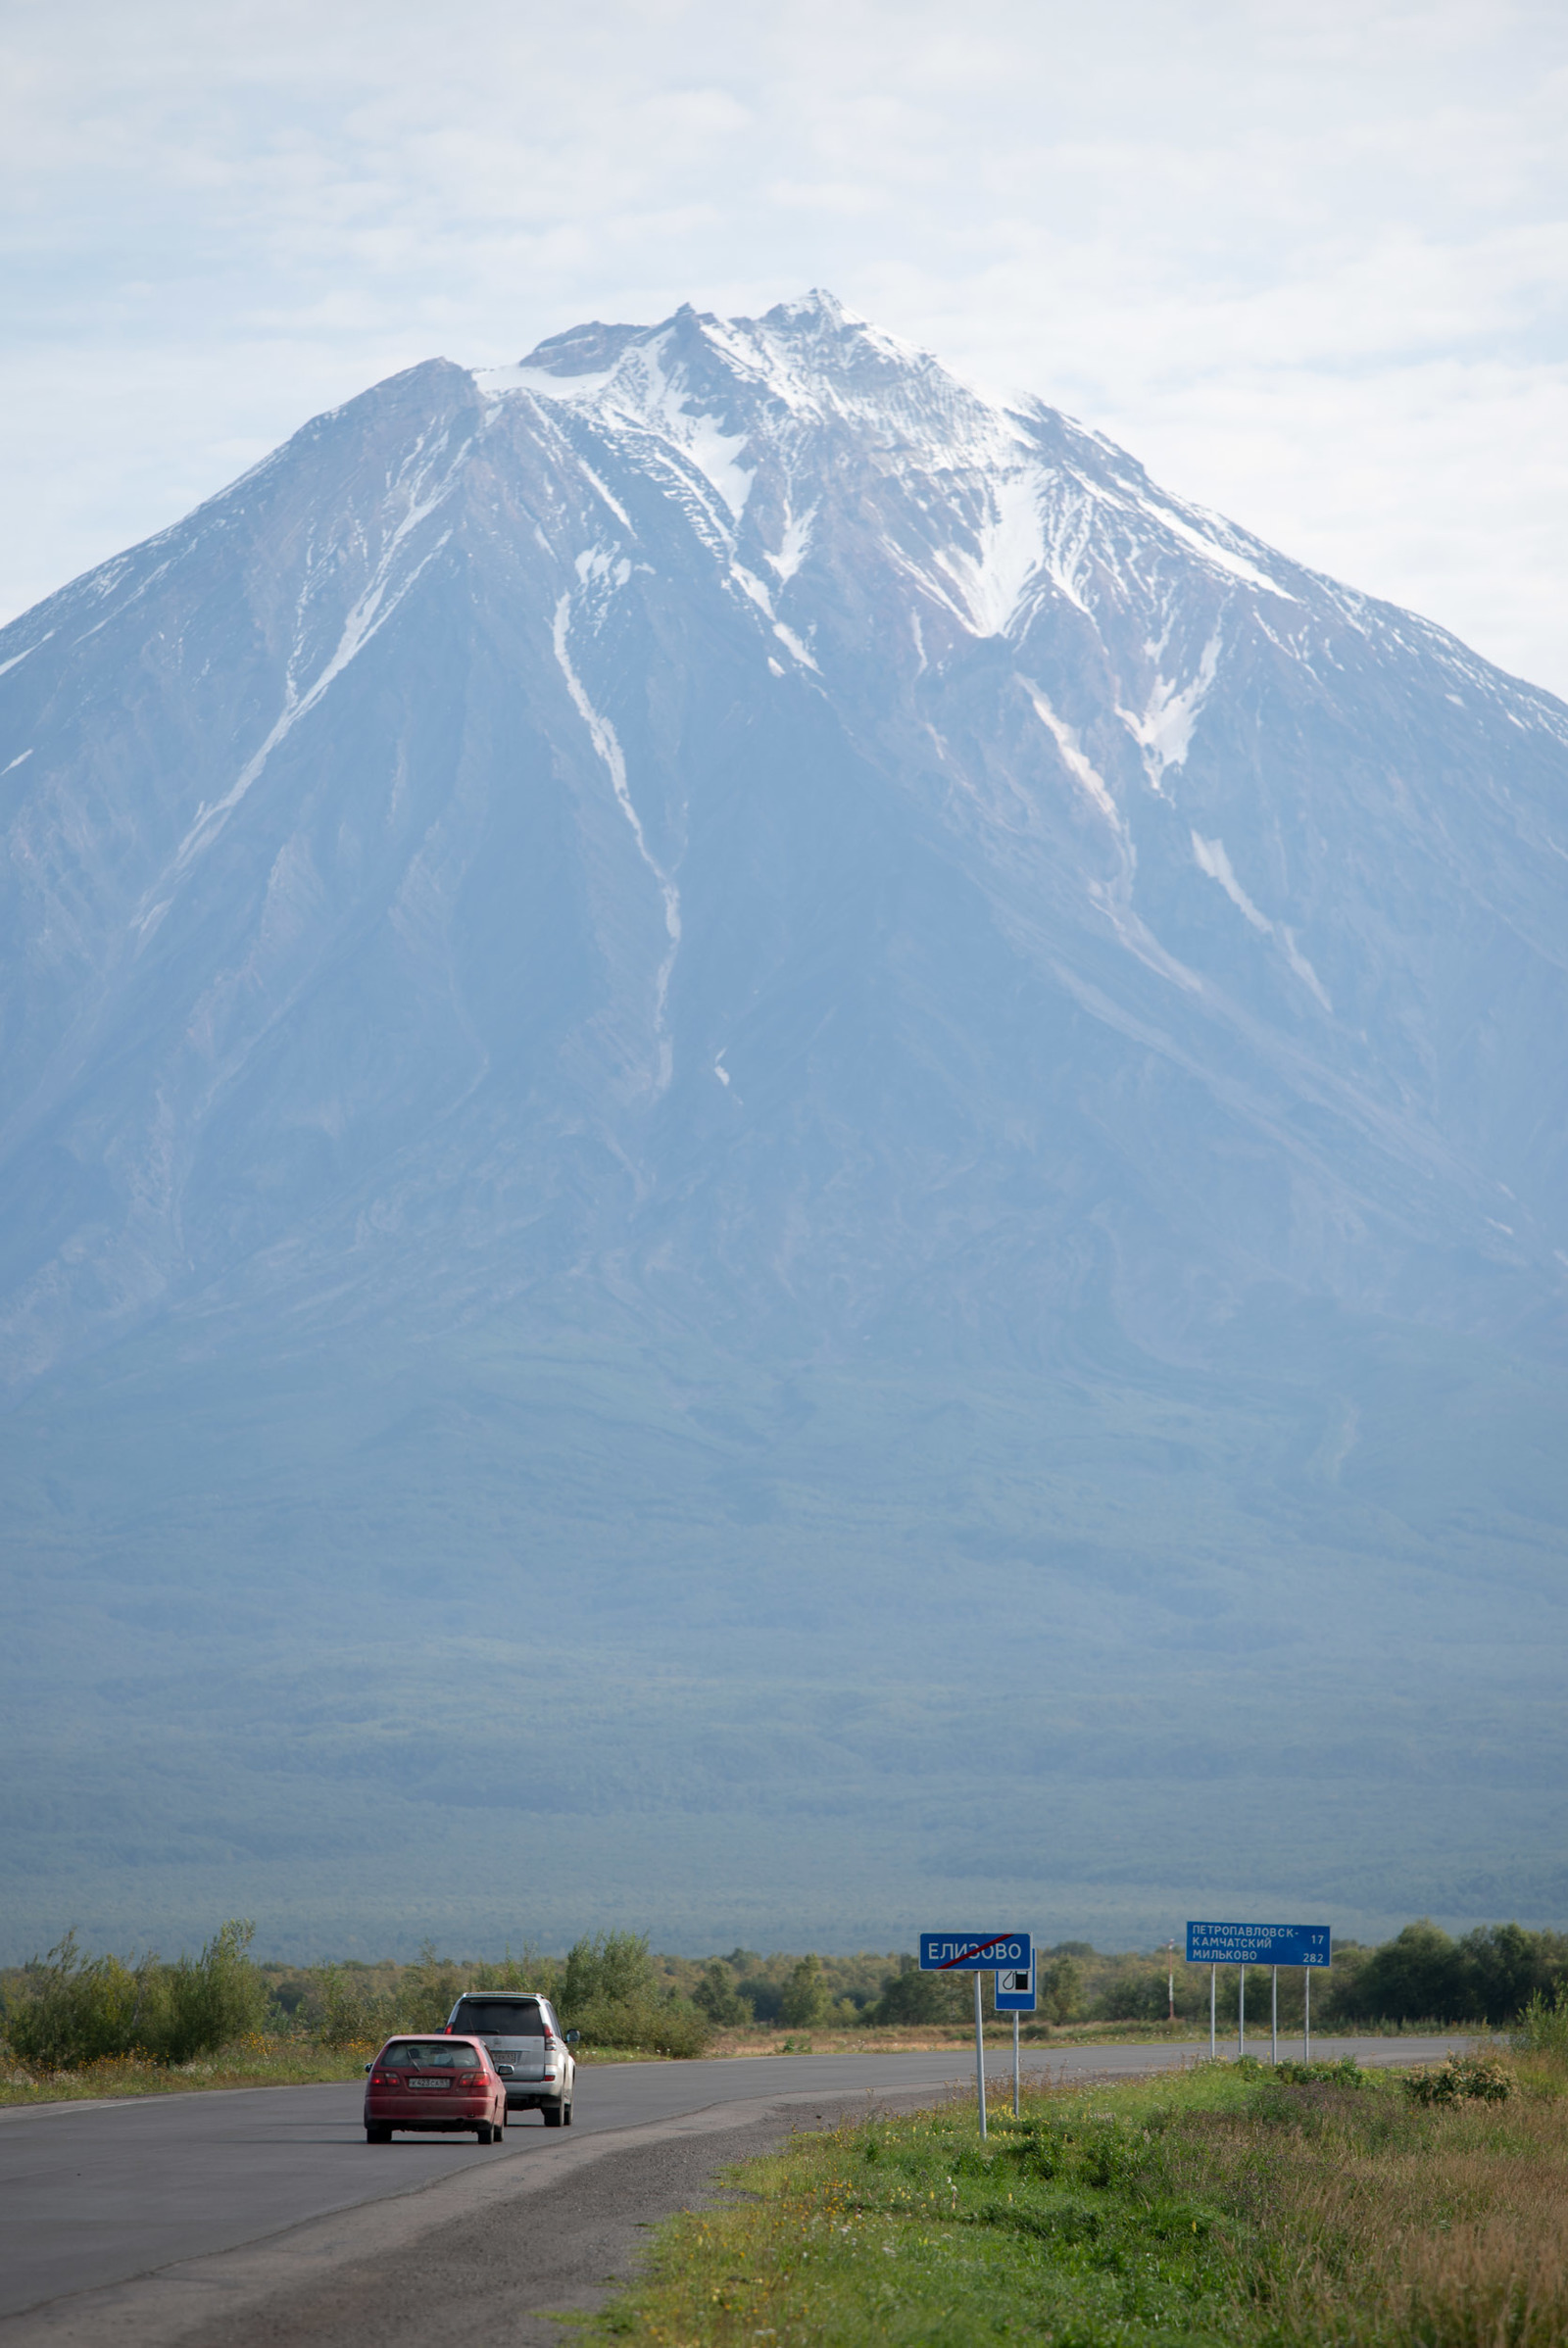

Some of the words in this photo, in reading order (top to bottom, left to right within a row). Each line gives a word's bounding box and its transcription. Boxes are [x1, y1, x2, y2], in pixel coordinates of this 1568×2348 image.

[1192, 1925, 1299, 1938] ПЕТРОПАВЛОВСК-
[1192, 1936, 1272, 1949] КАМЧАТСКИЙ
[1311, 1934, 1324, 1945] 17
[928, 1942, 1021, 1960] ЕЛИЗОВО
[1192, 1949, 1257, 1961] МИЛЬКОВО
[1302, 1953, 1324, 1963] 282
